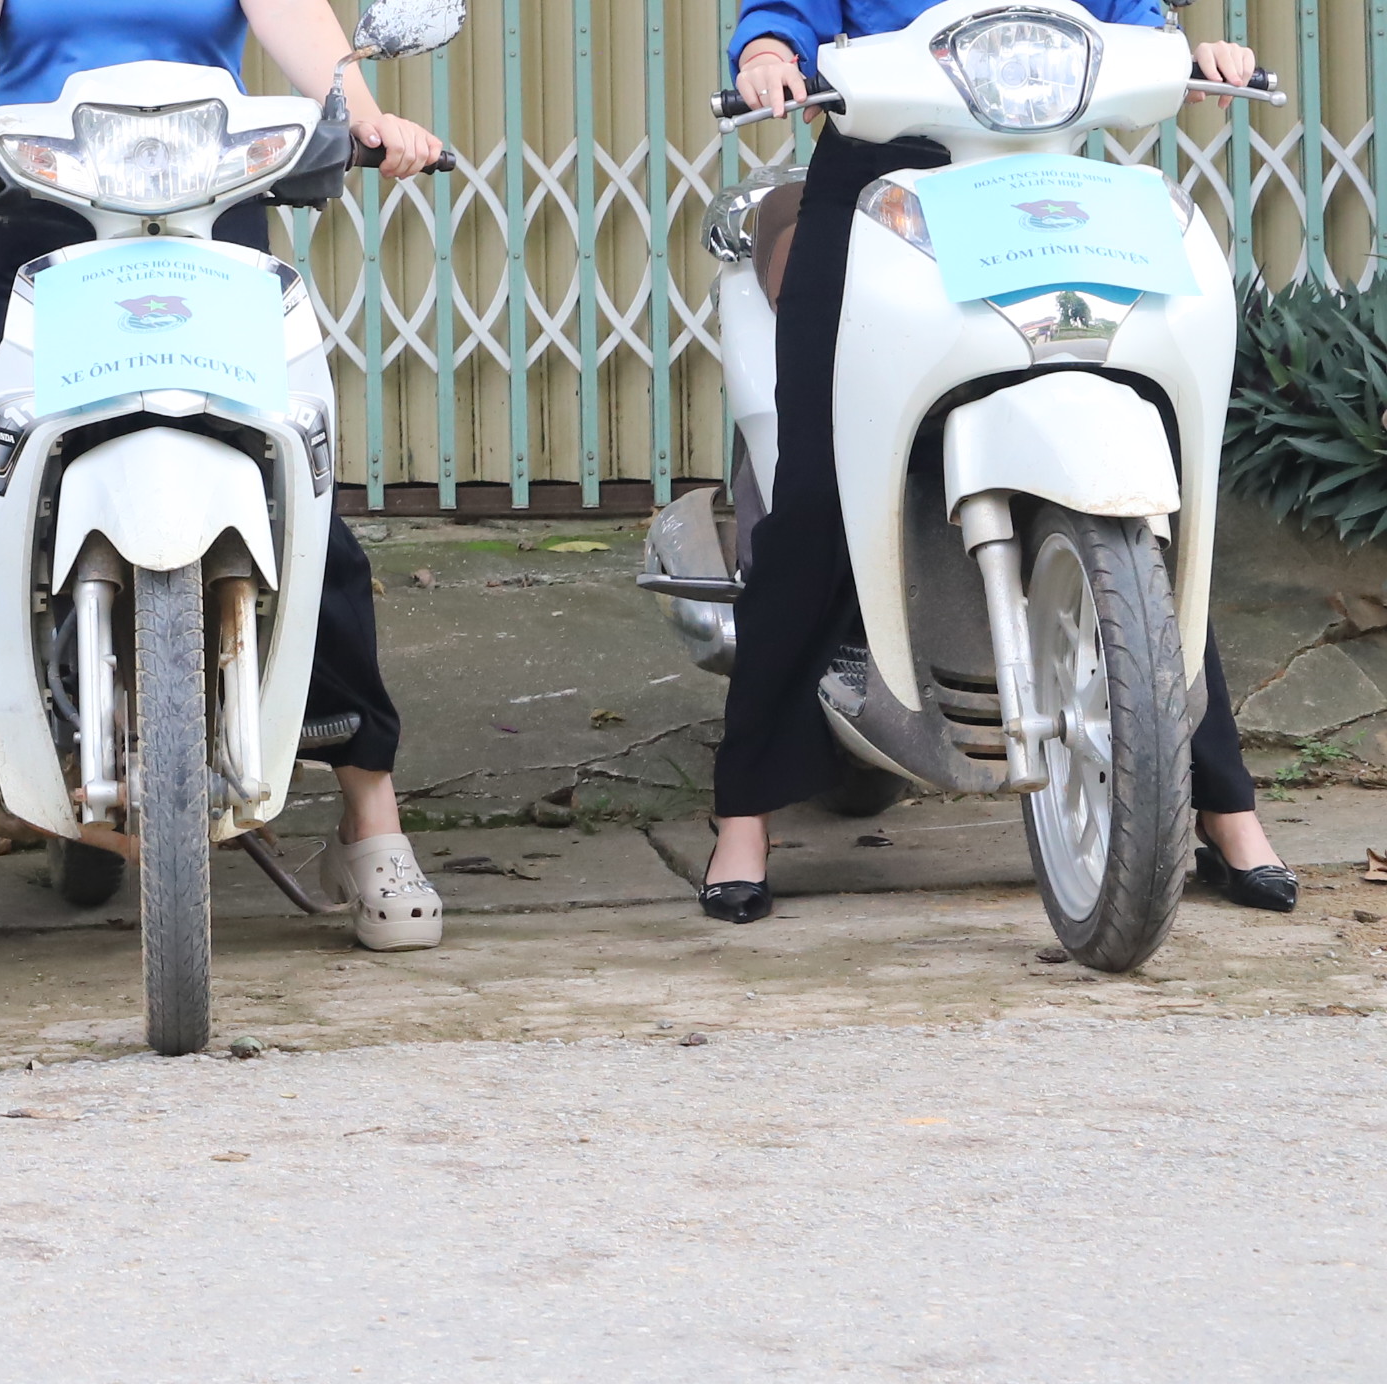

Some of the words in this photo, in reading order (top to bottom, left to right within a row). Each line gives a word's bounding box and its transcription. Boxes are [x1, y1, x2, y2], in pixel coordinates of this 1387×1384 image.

[1009, 171, 1040, 180] TNCS
[1040, 168, 1059, 177] HỒ
[1060, 170, 1082, 179] CHÍ
[1082, 173, 1113, 185] MINH
[1009, 180, 1027, 190] XÃ
[1027, 177, 1056, 188] LIÊN
[1057, 179, 1084, 189] HIỆP
[979, 254, 1002, 268] XE
[1004, 246, 1034, 262] ÔM
[1037, 242, 1080, 256] TÌNH
[1083, 245, 1150, 266] NGUYỆN
[116, 273, 135, 285] XÃ
[136, 270, 165, 281] LIÊN
[168, 272, 198, 284] HIỆP
[117, 261, 149, 273] TNCS
[152, 258, 172, 268] HỒ
[173, 260, 198, 272] CHÍ
[199, 265, 231, 281] MINH
[60, 369, 85, 388] XE
[89, 358, 120, 377] ÔM
[125, 351, 174, 369] TÌNH
[179, 352, 257, 384] NGUYỆN
